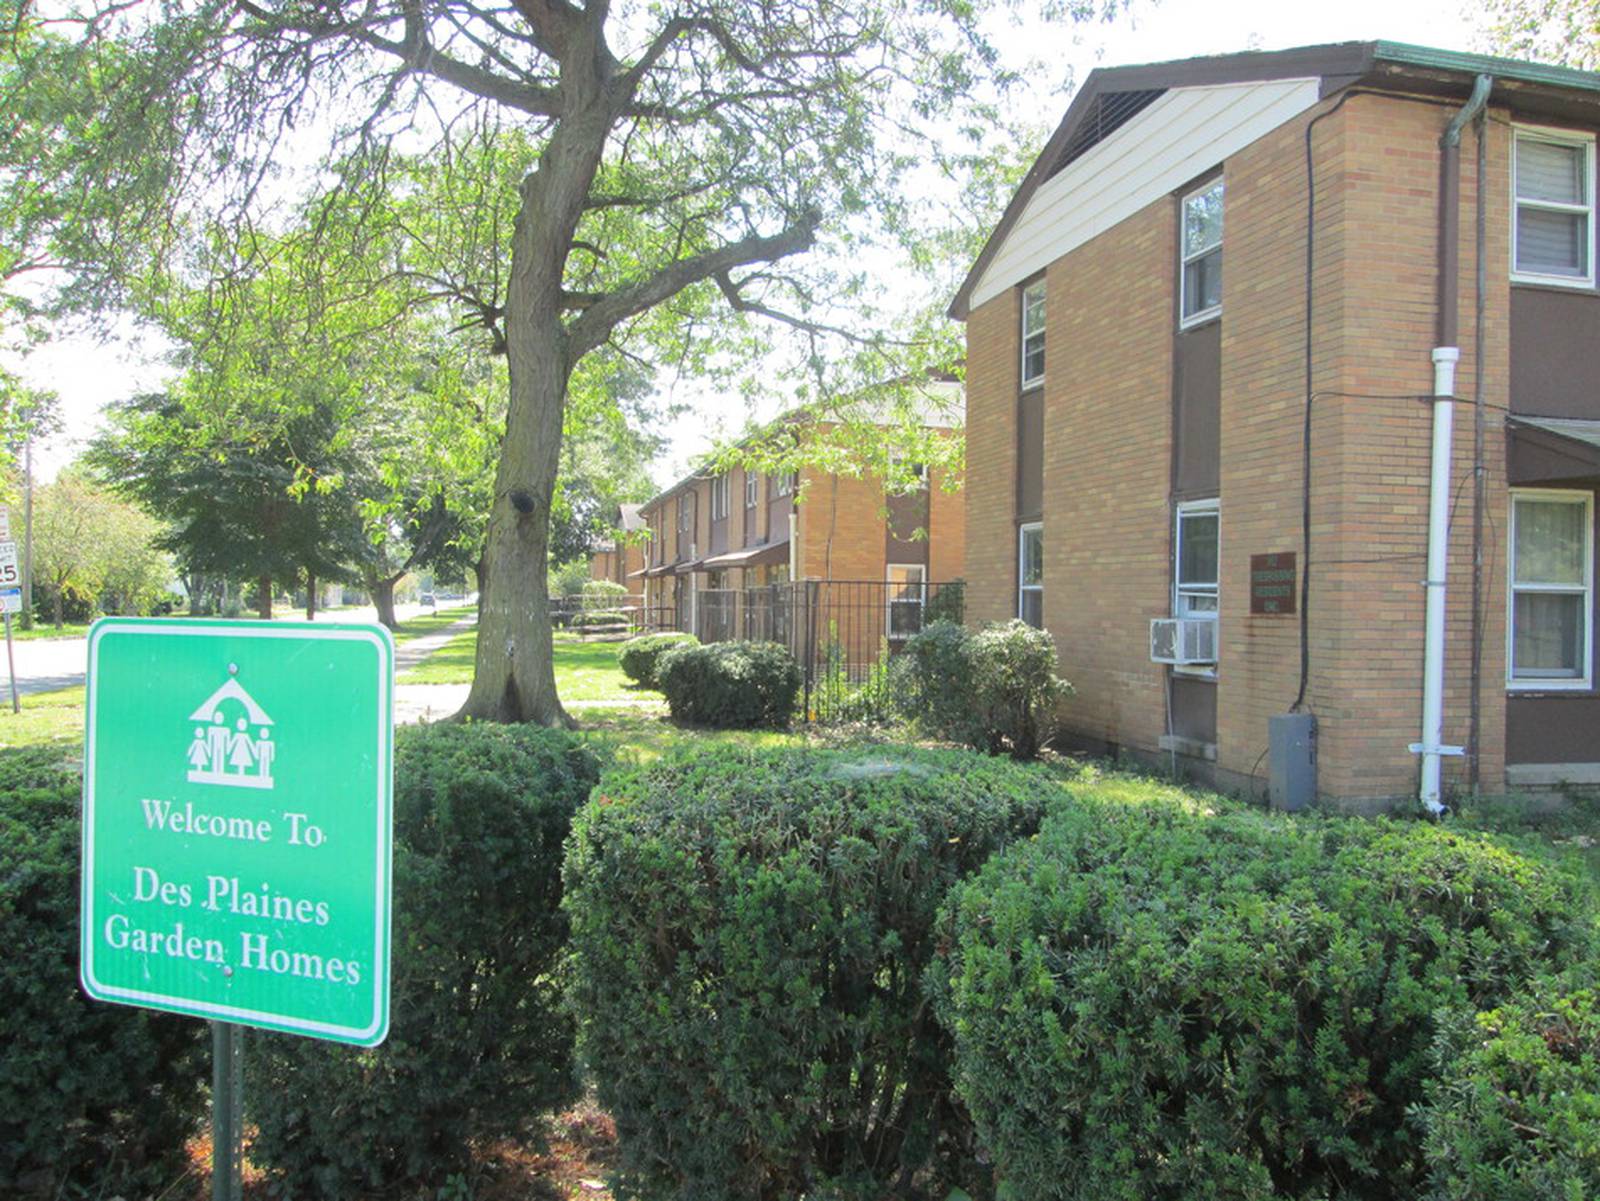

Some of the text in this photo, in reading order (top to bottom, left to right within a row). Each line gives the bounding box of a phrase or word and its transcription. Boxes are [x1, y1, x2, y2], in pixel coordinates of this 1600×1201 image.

[0, 564, 17, 582] 5
[141, 799, 323, 847] Welcome To
[133, 865, 330, 926] Des Plaines
[104, 914, 361, 985] Garden Homes
